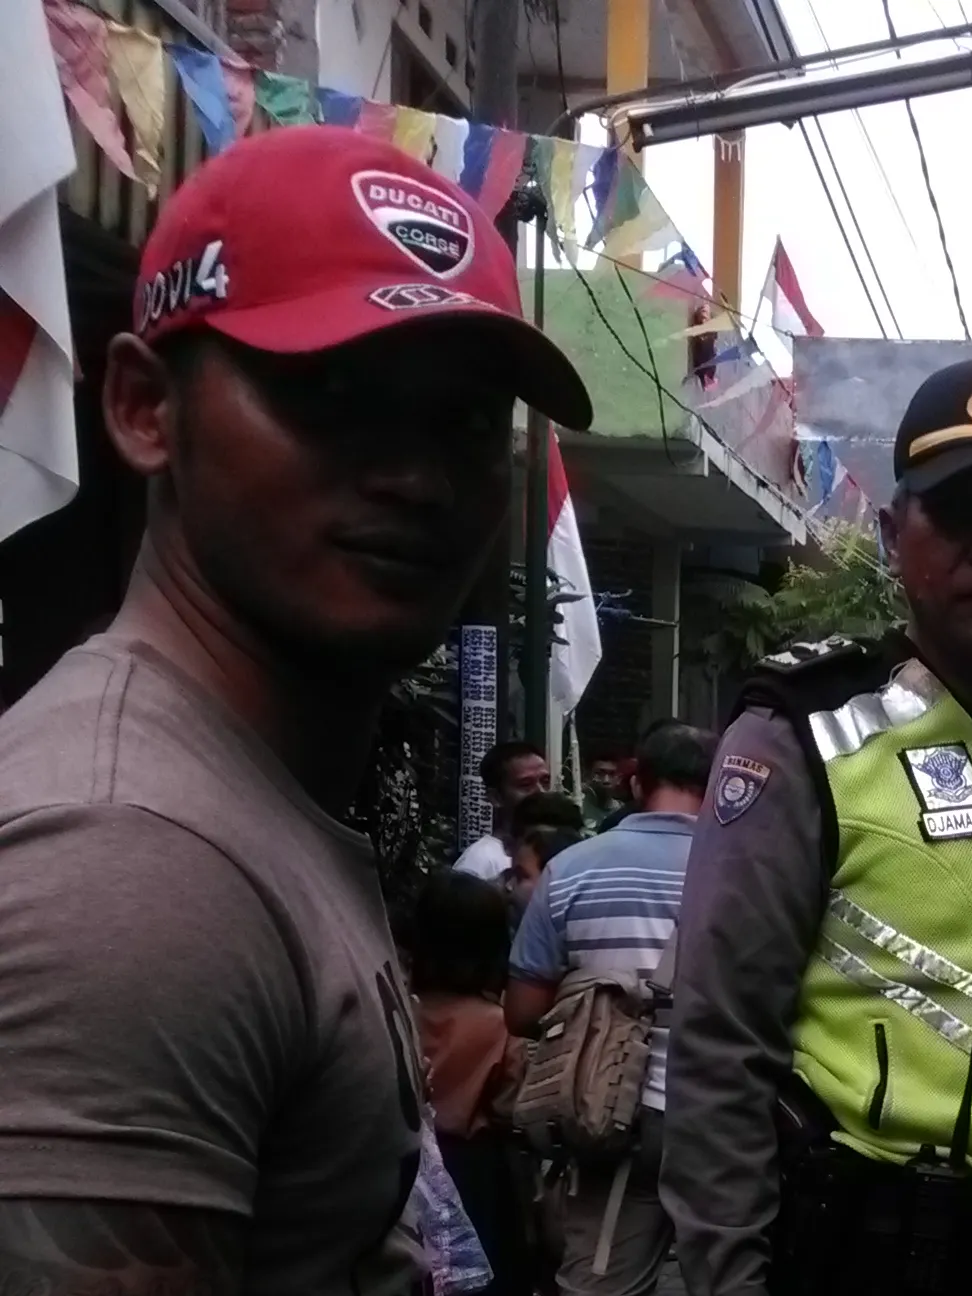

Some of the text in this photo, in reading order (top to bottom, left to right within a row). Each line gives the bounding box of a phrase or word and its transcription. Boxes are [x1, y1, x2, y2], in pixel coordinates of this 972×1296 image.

[369, 184, 460, 226] DUCATI
[395, 225, 460, 258] CORSE
[463, 706, 471, 724] WC
